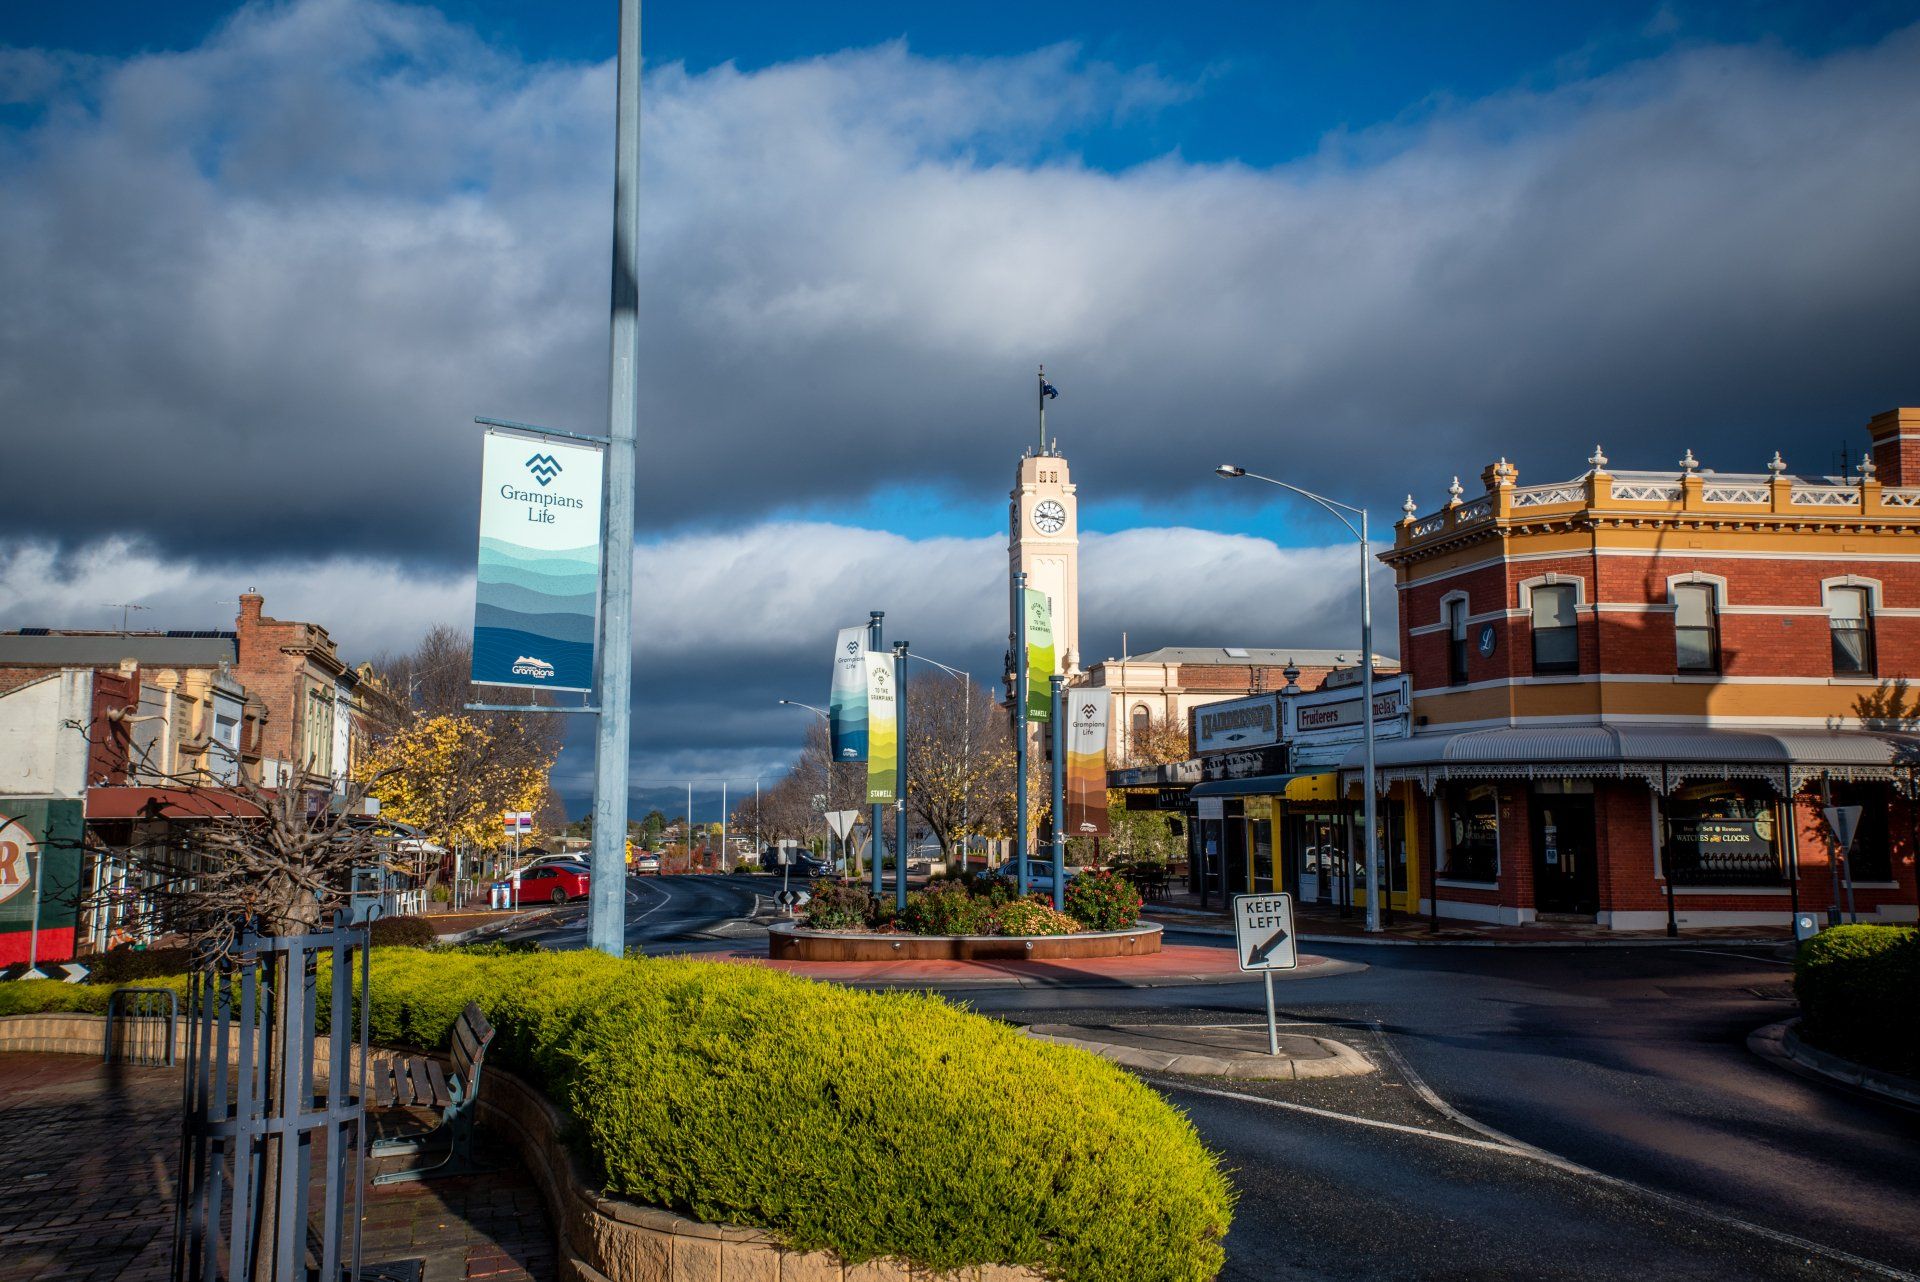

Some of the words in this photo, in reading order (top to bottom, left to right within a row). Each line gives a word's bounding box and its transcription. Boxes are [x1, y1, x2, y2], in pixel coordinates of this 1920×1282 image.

[501, 484, 584, 509] Grampians
[528, 507, 555, 524] Life
[512, 665, 555, 677] Grampians
[872, 667, 890, 678] GATEWAY
[870, 694, 894, 702] GRAMPIANS
[1030, 709, 1047, 717] STAWELL
[1301, 708, 1338, 726] Fruiterers
[1372, 698, 1396, 716] mela's
[870, 789, 892, 798] STAWELL
[1722, 834, 1750, 842] CLOCKS
[1246, 901, 1282, 914] KEEP
[1249, 916, 1282, 929] LEFT
